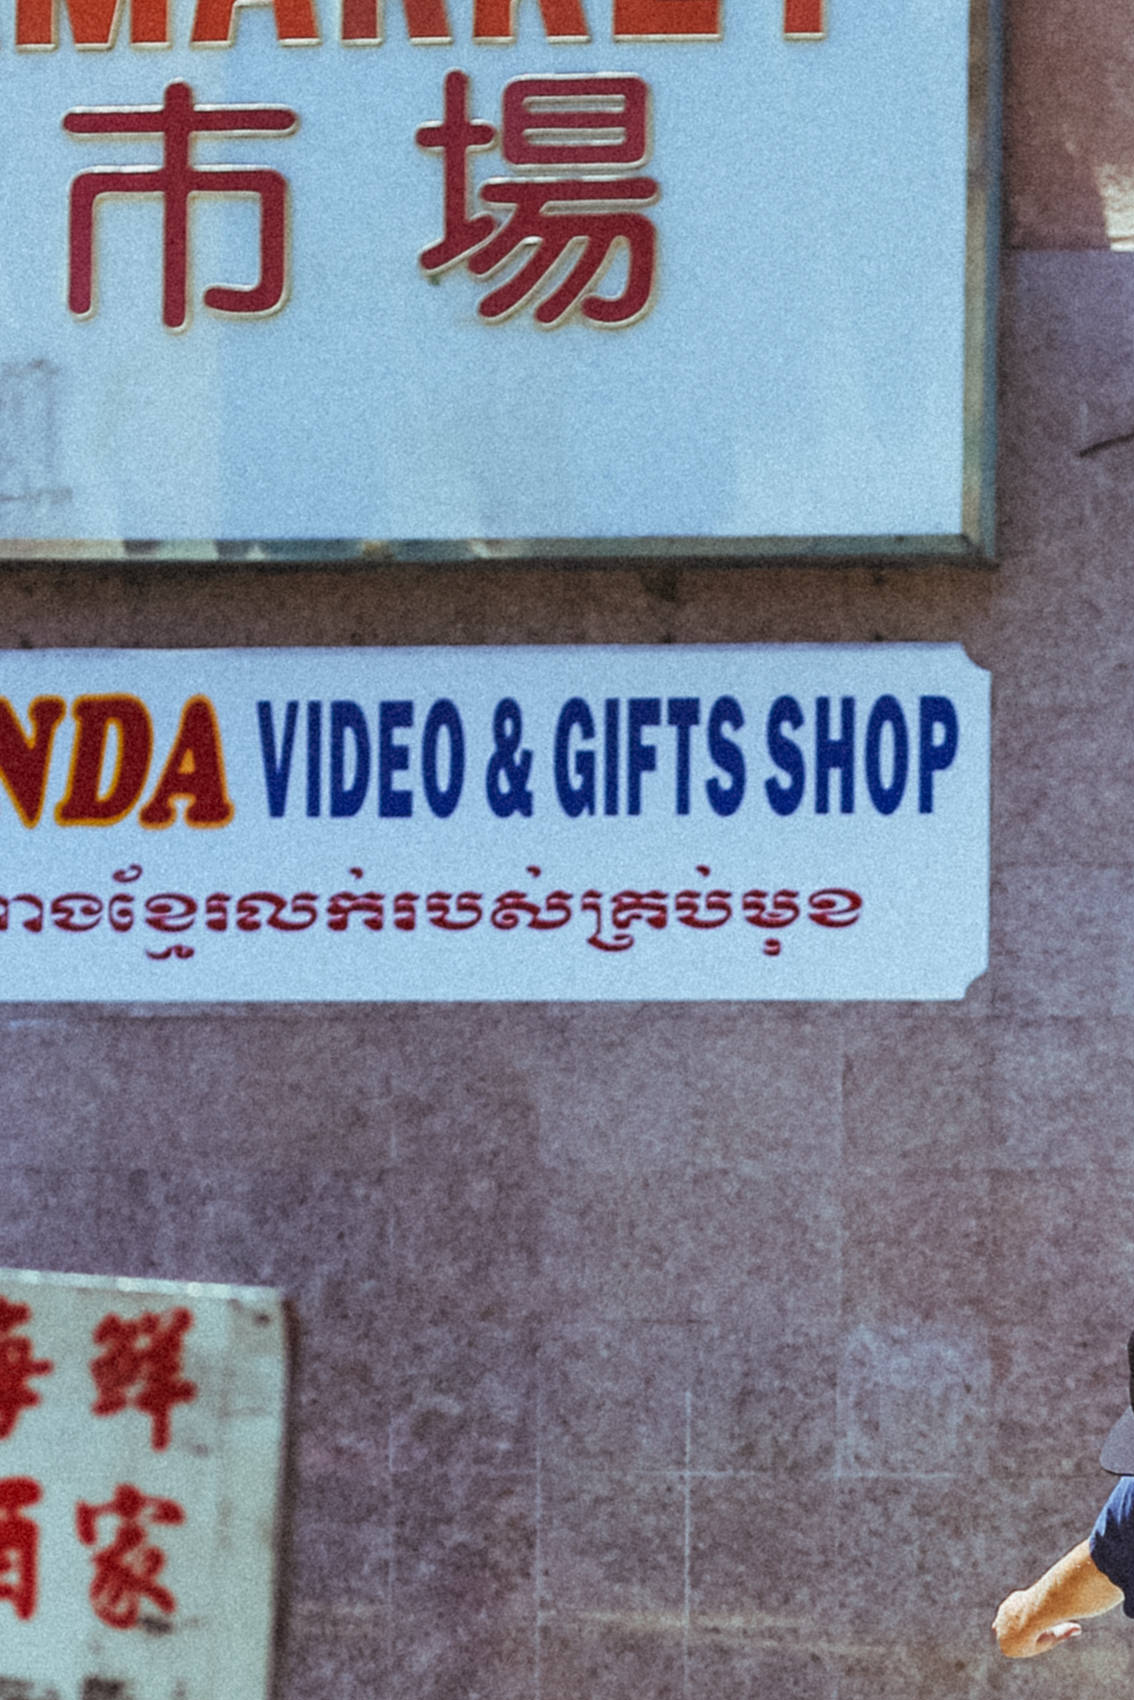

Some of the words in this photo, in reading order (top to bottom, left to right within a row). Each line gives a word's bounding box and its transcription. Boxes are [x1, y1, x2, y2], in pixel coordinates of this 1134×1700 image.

[61, 69, 659, 331] 市場
[256, 698, 466, 819] VIDEO
[484, 697, 534, 818] &
[553, 695, 747, 818] GIFTS
[764, 694, 960, 817] SHOP
